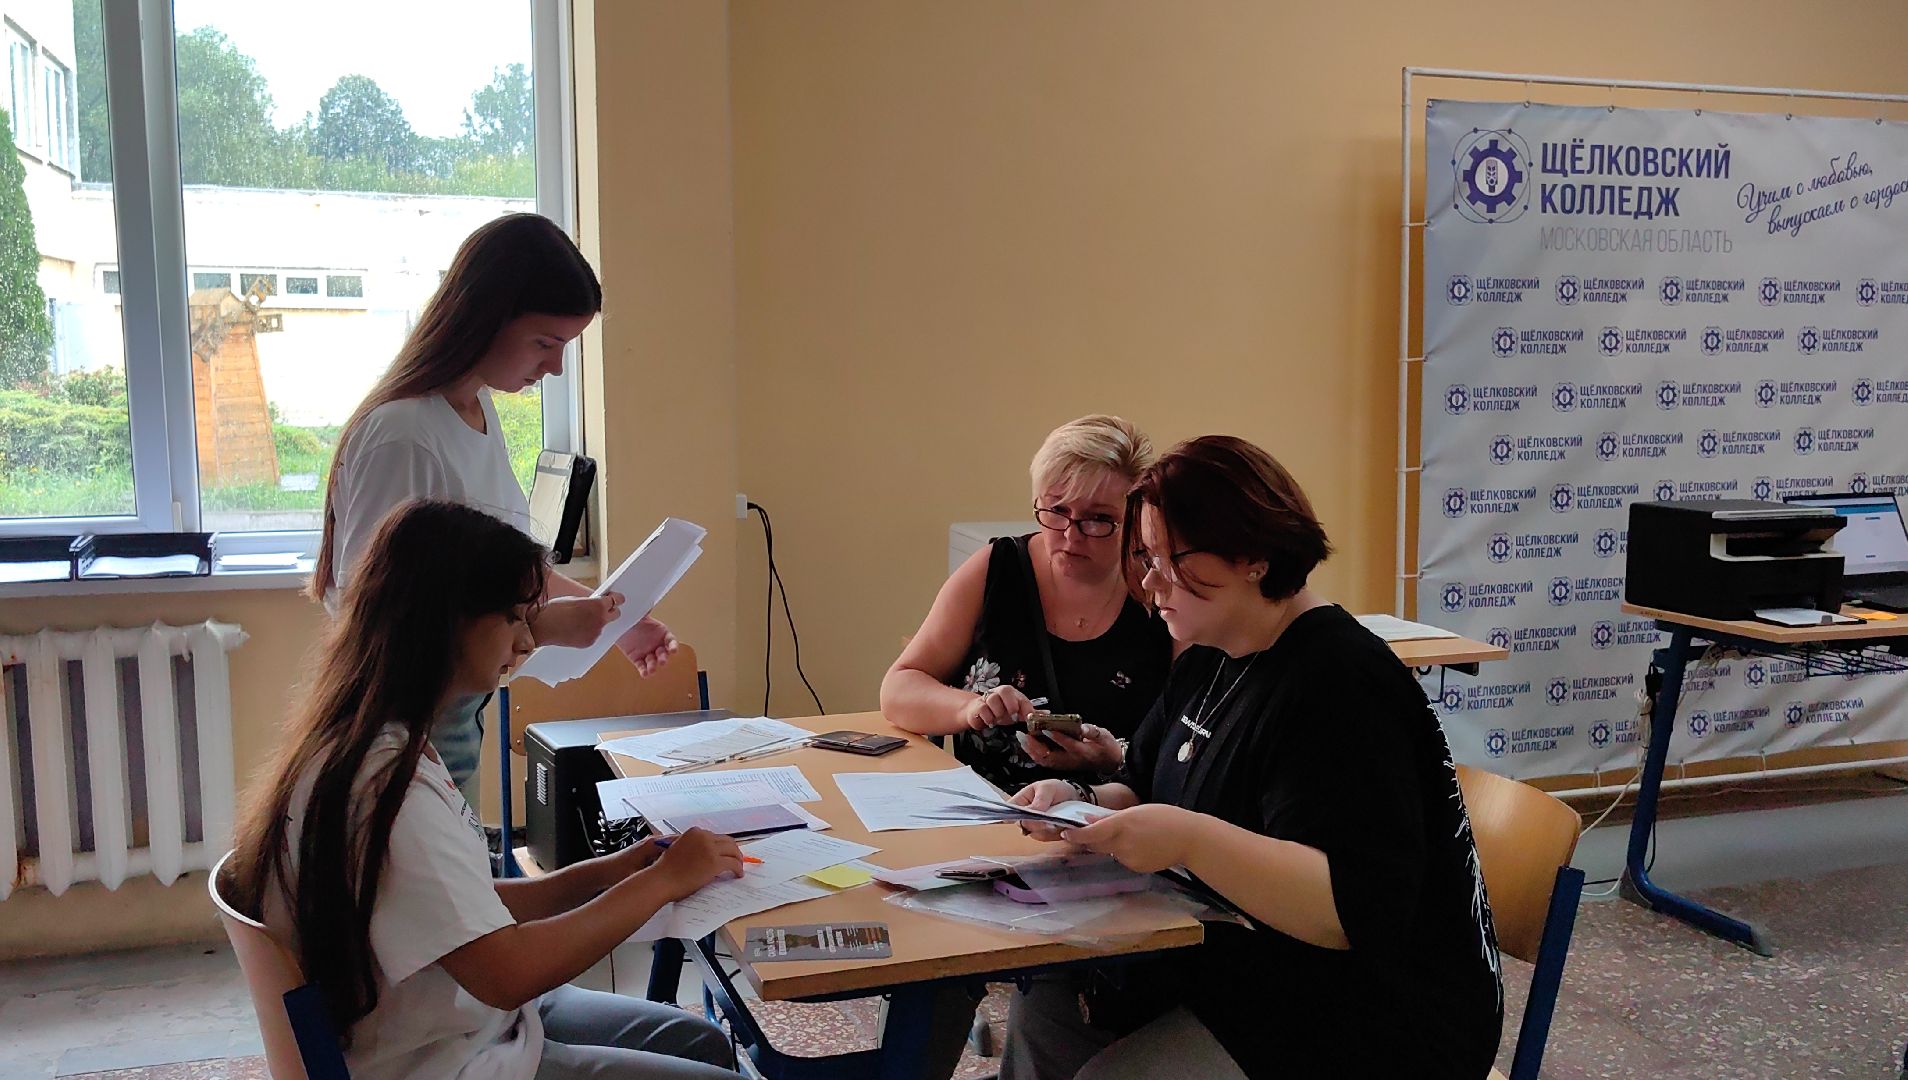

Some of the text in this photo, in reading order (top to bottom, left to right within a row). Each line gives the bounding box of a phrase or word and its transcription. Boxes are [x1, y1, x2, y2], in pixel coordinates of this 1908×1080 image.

[1541, 138, 1731, 179] ЩЁЛКОВСКИЙ
[1540, 183, 1680, 220] КОЛЛЕДЖ
[1737, 182, 1792, 223] Учим
[1768, 200, 1845, 238] выпускаем
[1863, 179, 1908, 209] гордос
[1540, 226, 1733, 253] МОСКОВСКАЯ ОБЛАСТЬ
[1476, 277, 1540, 290] ЩЁЛКОВСКИЙ
[1583, 278, 1644, 290] ЩЁЛКОВСКИЙ
[1686, 278, 1744, 290] ЩЁЛКОВСКИЙ
[1784, 279, 1840, 292] ЩЁЛКОВСКИЙ
[1880, 280, 1908, 292] ЩЁЛКО
[1476, 292, 1522, 303] КОЛЛЕДЖ
[1583, 292, 1628, 303] КОЛЛЕДЖ
[1686, 293, 1728, 304] КОЛЛЕДЖ
[1784, 294, 1825, 304] КОЛЛЕДЖ
[1521, 328, 1584, 341] ЩЁЛКОВСКИЙ
[1626, 328, 1686, 340] ЩЁЛКОВСКИЙ
[1726, 328, 1784, 340] ЩЁЛКОВСКИЙ
[1823, 328, 1878, 340] ЩЁЛКОВСКИЙ
[1521, 343, 1567, 354] КОЛЛЕДЖ
[1626, 342, 1670, 353] КОЛЛЕДЖ
[1726, 342, 1768, 353] КОЛЛЕДЖ
[1822, 342, 1863, 352] КОЛЛЕДЖ
[1473, 384, 1537, 398] ЩЁЛКОВСКИЙ
[1580, 383, 1642, 396] ЩЁЛКОВСКИЙ
[1683, 382, 1741, 394] ЩЁЛКОВСКИЙ
[1780, 380, 1836, 392] ЩЁЛКОВСКИЙ
[1580, 398, 1626, 408] КОЛЛЕДЖ
[1682, 396, 1725, 406] КОЛЛЕДЖ
[1780, 394, 1822, 405] КОЛЛЕДЖ
[1473, 401, 1520, 411] КОЛЛЕДЖ
[1623, 432, 1683, 445] ЩЁЛКОВСКИЙ
[1723, 429, 1780, 442] ЩЁЛКОВСКИЙ
[1818, 428, 1874, 440] ЩЁЛКОВСКИЙ
[1518, 434, 1583, 448] ЩЁЛКОВСКИЙ
[1818, 441, 1859, 452] КОЛЛЕДЖ
[1623, 446, 1666, 457] КОЛЛЕДЖ
[1723, 444, 1765, 454] КОЛЛЕДЖ
[1518, 450, 1565, 461] КОЛЛЕДЖ
[1680, 480, 1738, 493] ЩЁЛКОВСКИЙ
[1776, 476, 1833, 489] ЩЁЛКОВСКИЙ
[1470, 486, 1536, 500] ЩЁЛКОВСКИЙ
[1577, 483, 1639, 496] ЩЁЛКОВСКИЙ
[1470, 502, 1519, 514] КОЛЛЕДЖ
[1577, 498, 1622, 509] КОЛЛЕДЖ
[1516, 532, 1578, 546] ЩЁЛКОВСКИЙ
[1516, 547, 1562, 558] КОЛЛЕДЖ
[1469, 580, 1533, 596] ЩЁЛКОВСКИЙ
[1575, 576, 1624, 590] ЩЁЛКОВСК
[1469, 596, 1516, 608] КОЛЛЕДЖ
[1575, 590, 1620, 602] КОЛЛЕДЖ
[1514, 624, 1576, 640] ЩЁЛКОВСКИЙ
[1618, 620, 1655, 632] ЩЁЛКОВ
[1618, 632, 1661, 644] КОЛЛЕДЖ
[1514, 640, 1560, 652] КОЛЛЕДЖ
[1573, 674, 1633, 690] ЩЁЛКОВСКИЙ
[1468, 682, 1530, 698] ЩЁЛКОВСКИЙ
[1573, 690, 1617, 700] КОЛЛЕДЖ
[1468, 698, 1514, 710] КОЛЛЕДЖ
[1512, 724, 1574, 741] ЩЁЛКОВСКИЙ
[1512, 741, 1557, 754] КОЛЛЕДЖ
